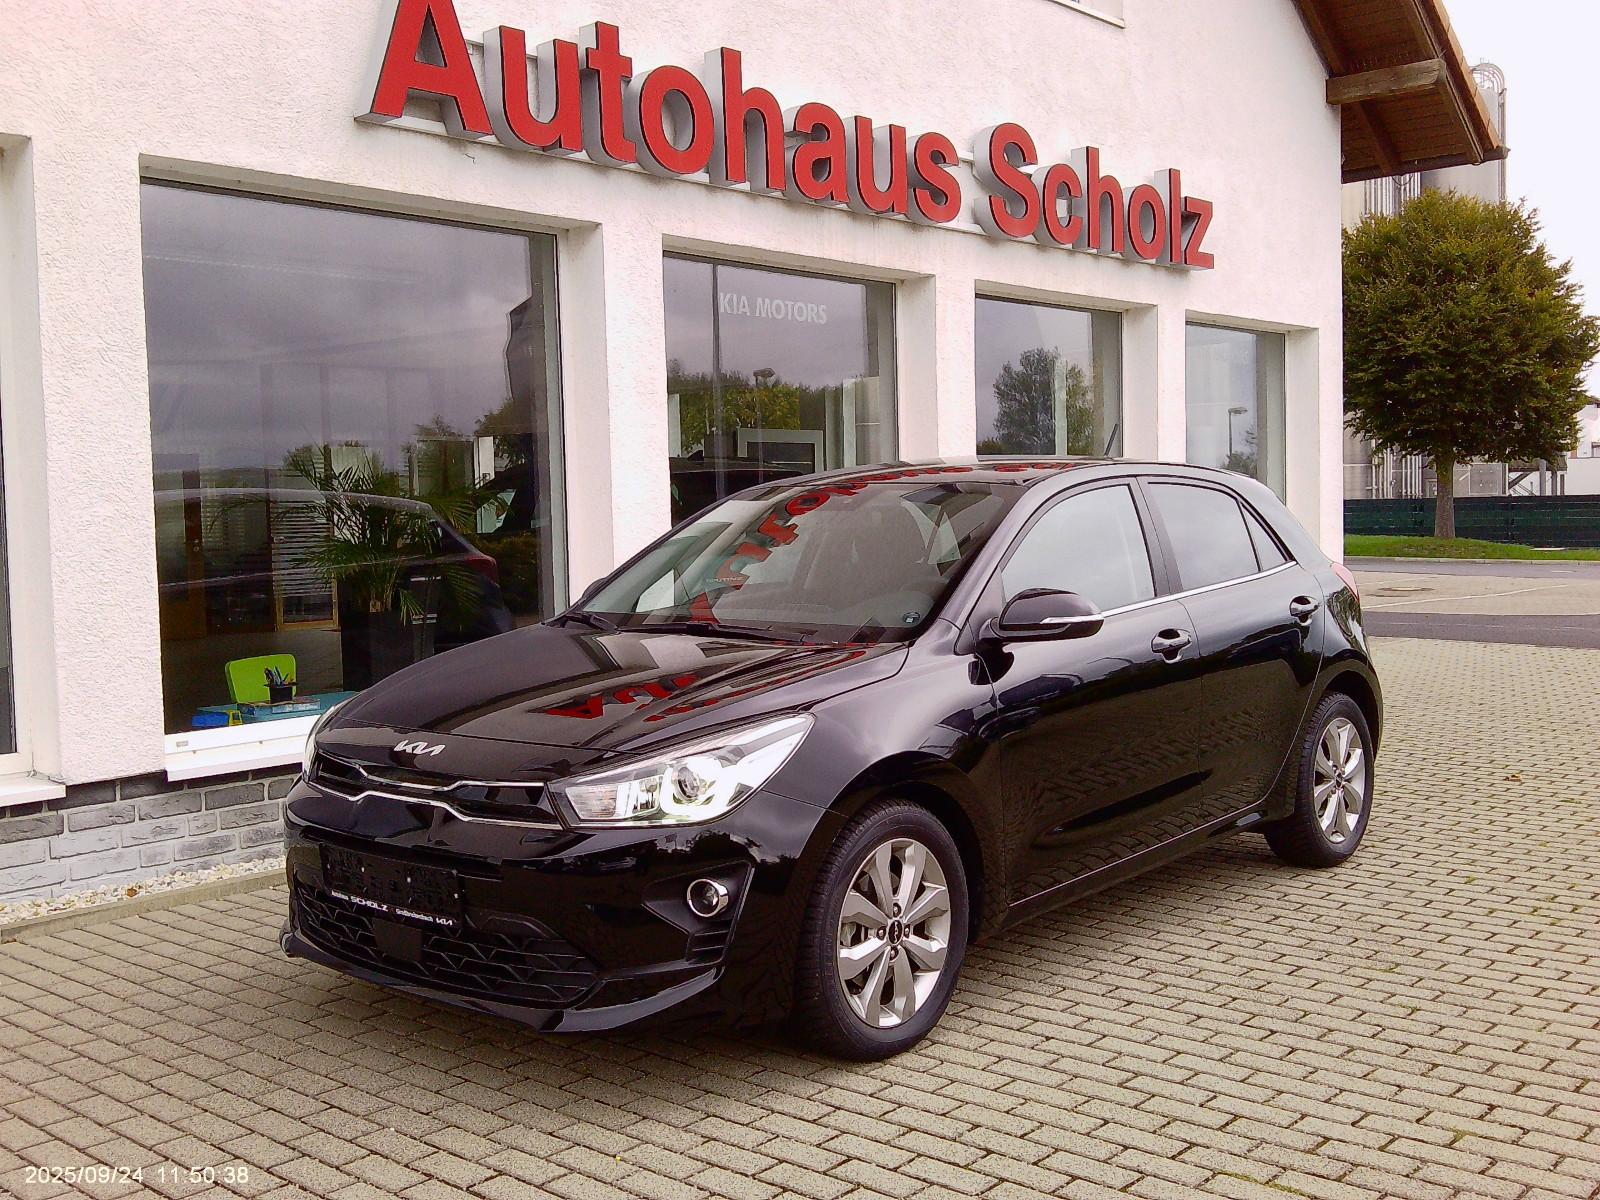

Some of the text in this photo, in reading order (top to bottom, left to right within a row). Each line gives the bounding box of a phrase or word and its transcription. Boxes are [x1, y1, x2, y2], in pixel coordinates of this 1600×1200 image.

[368, 0, 1214, 269] Autohaus Scholz
[720, 292, 827, 325] KIA MOTORS
[350, 895, 389, 912] SCHOLZ
